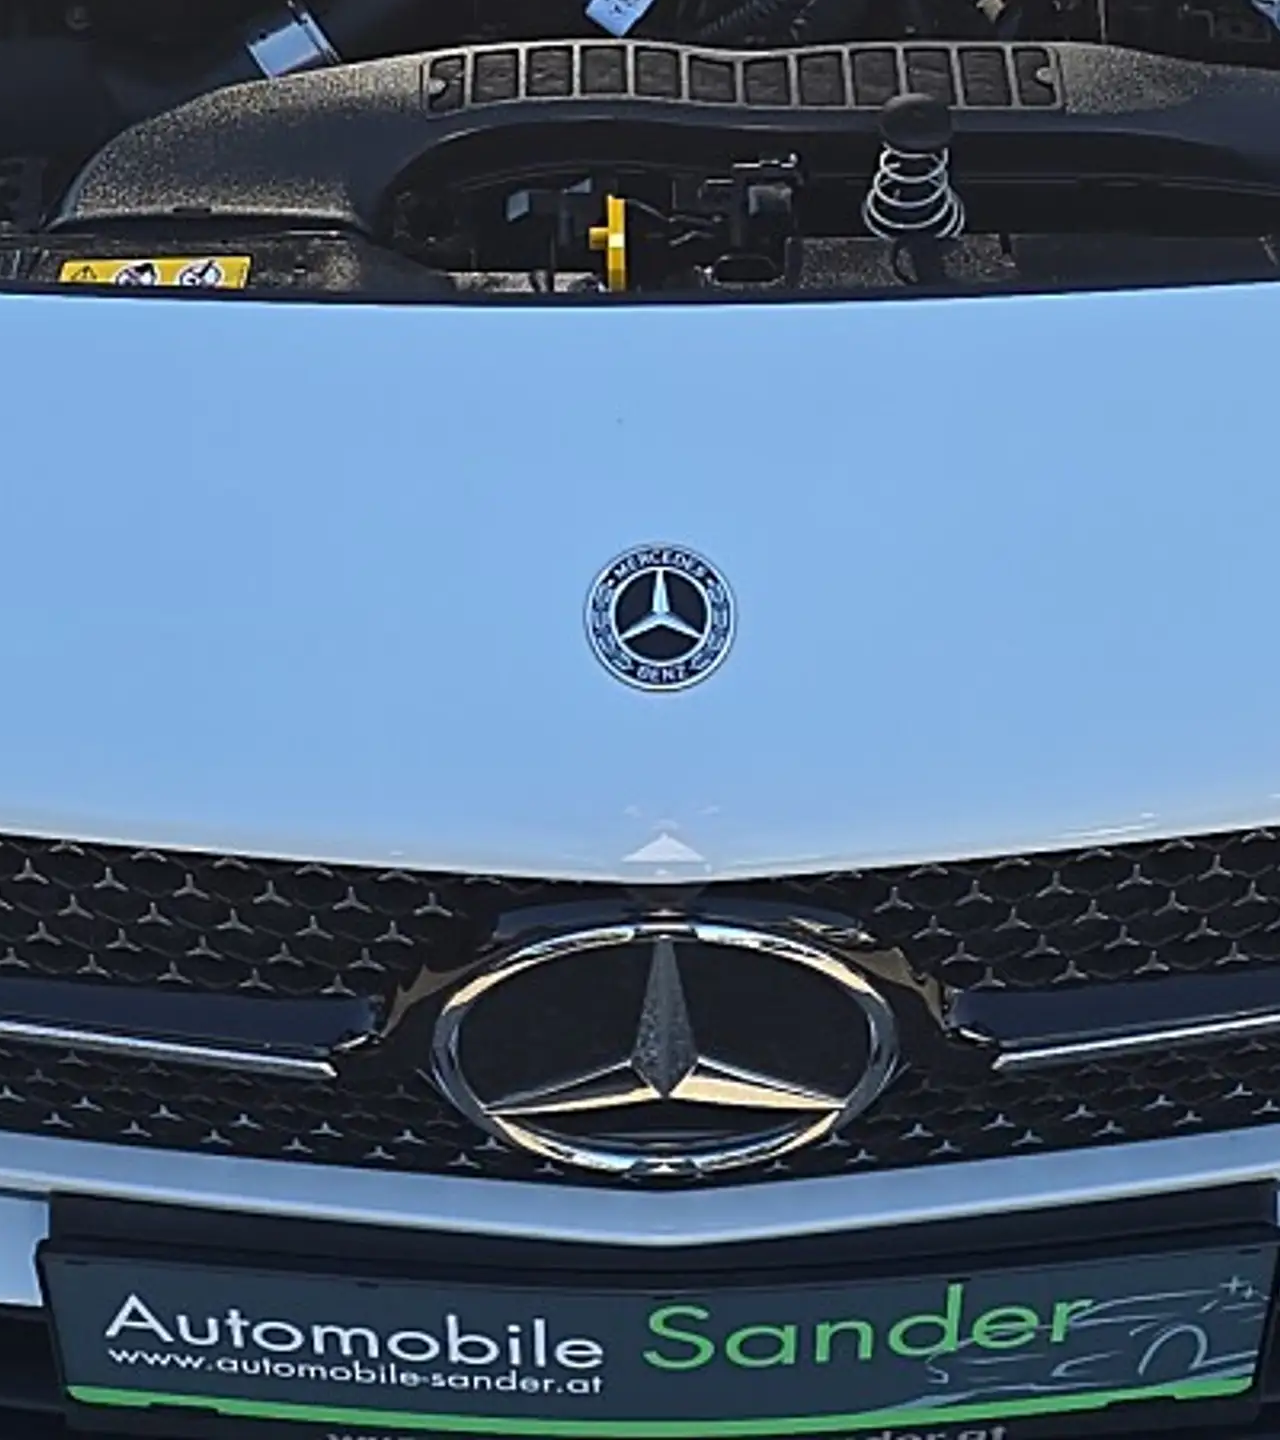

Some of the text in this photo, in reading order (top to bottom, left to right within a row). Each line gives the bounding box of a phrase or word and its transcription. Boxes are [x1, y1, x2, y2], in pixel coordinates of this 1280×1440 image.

[104, 1283, 1092, 1370] Automobile Sander
[108, 1348, 602, 1394] www.automobile-sander.at
